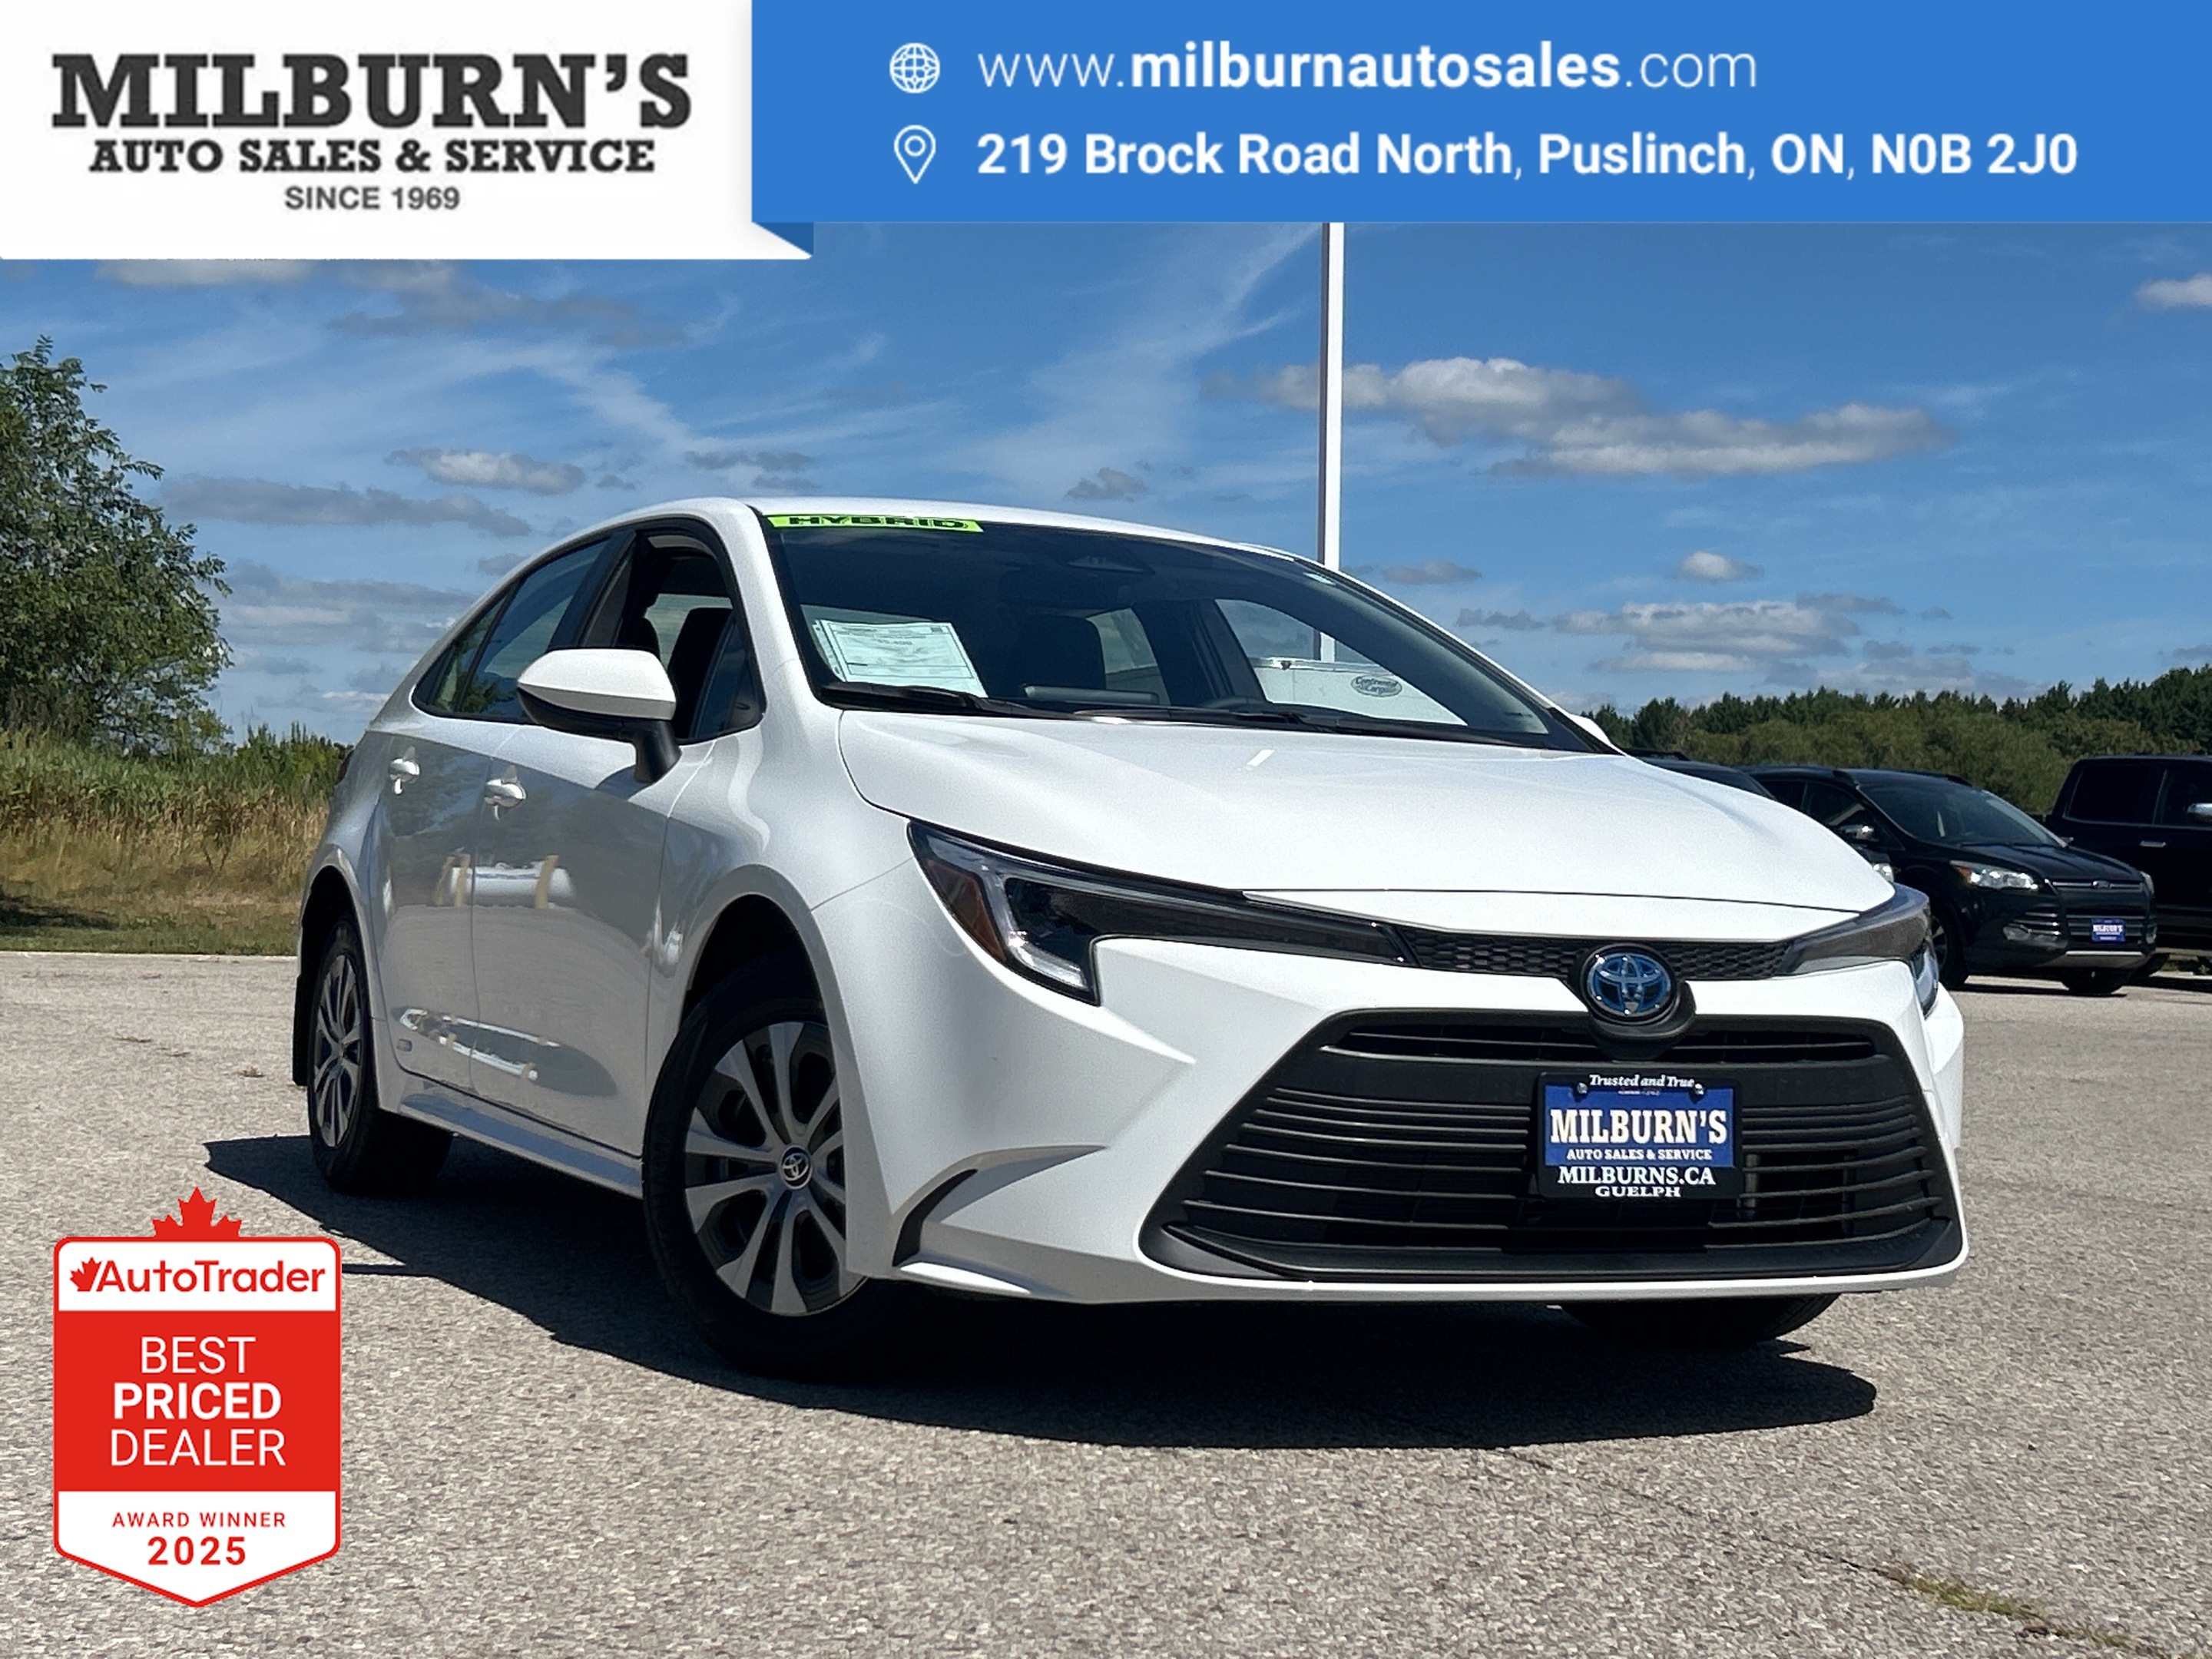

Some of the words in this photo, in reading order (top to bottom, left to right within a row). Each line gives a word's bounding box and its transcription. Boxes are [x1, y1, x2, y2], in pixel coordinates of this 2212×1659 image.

[789, 516, 969, 529] HYBRID
[1589, 1074, 1639, 1088] Trusted
[1640, 1074, 1665, 1088] and
[1666, 1076, 1695, 1088] True
[1550, 1109, 1727, 1144] MILBURN'S
[1566, 1148, 1603, 1161] AUTO
[1605, 1148, 1645, 1161] SALES
[1646, 1149, 1657, 1161] &
[1657, 1148, 1714, 1161] SERVICE
[1557, 1166, 1717, 1185] MILBURNS.CA
[1594, 1186, 1682, 1197] GUELPH
